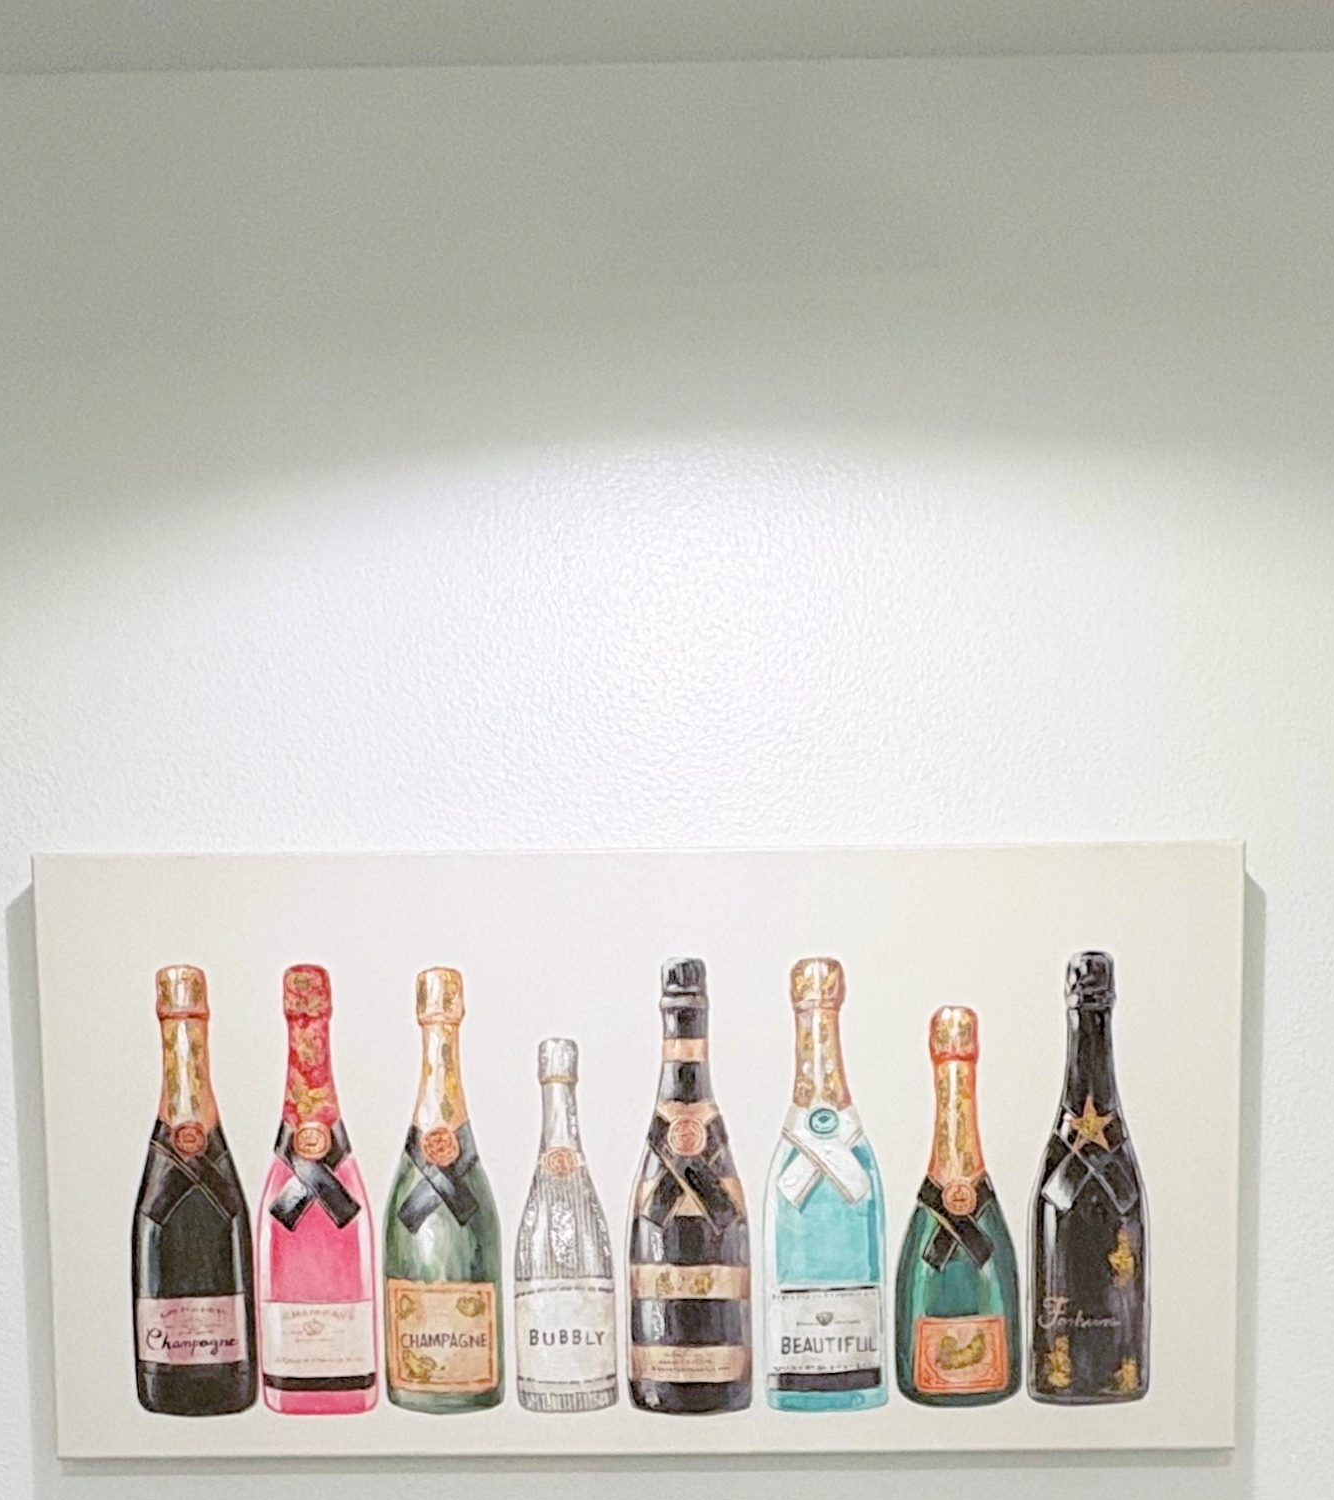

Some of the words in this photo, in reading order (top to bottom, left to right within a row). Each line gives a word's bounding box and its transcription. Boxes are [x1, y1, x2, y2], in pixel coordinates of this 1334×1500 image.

[400, 1331, 488, 1349] CHAMPAGNE
[528, 1328, 605, 1347] BUBBLY
[780, 1335, 878, 1355] BEAUTIFUL
